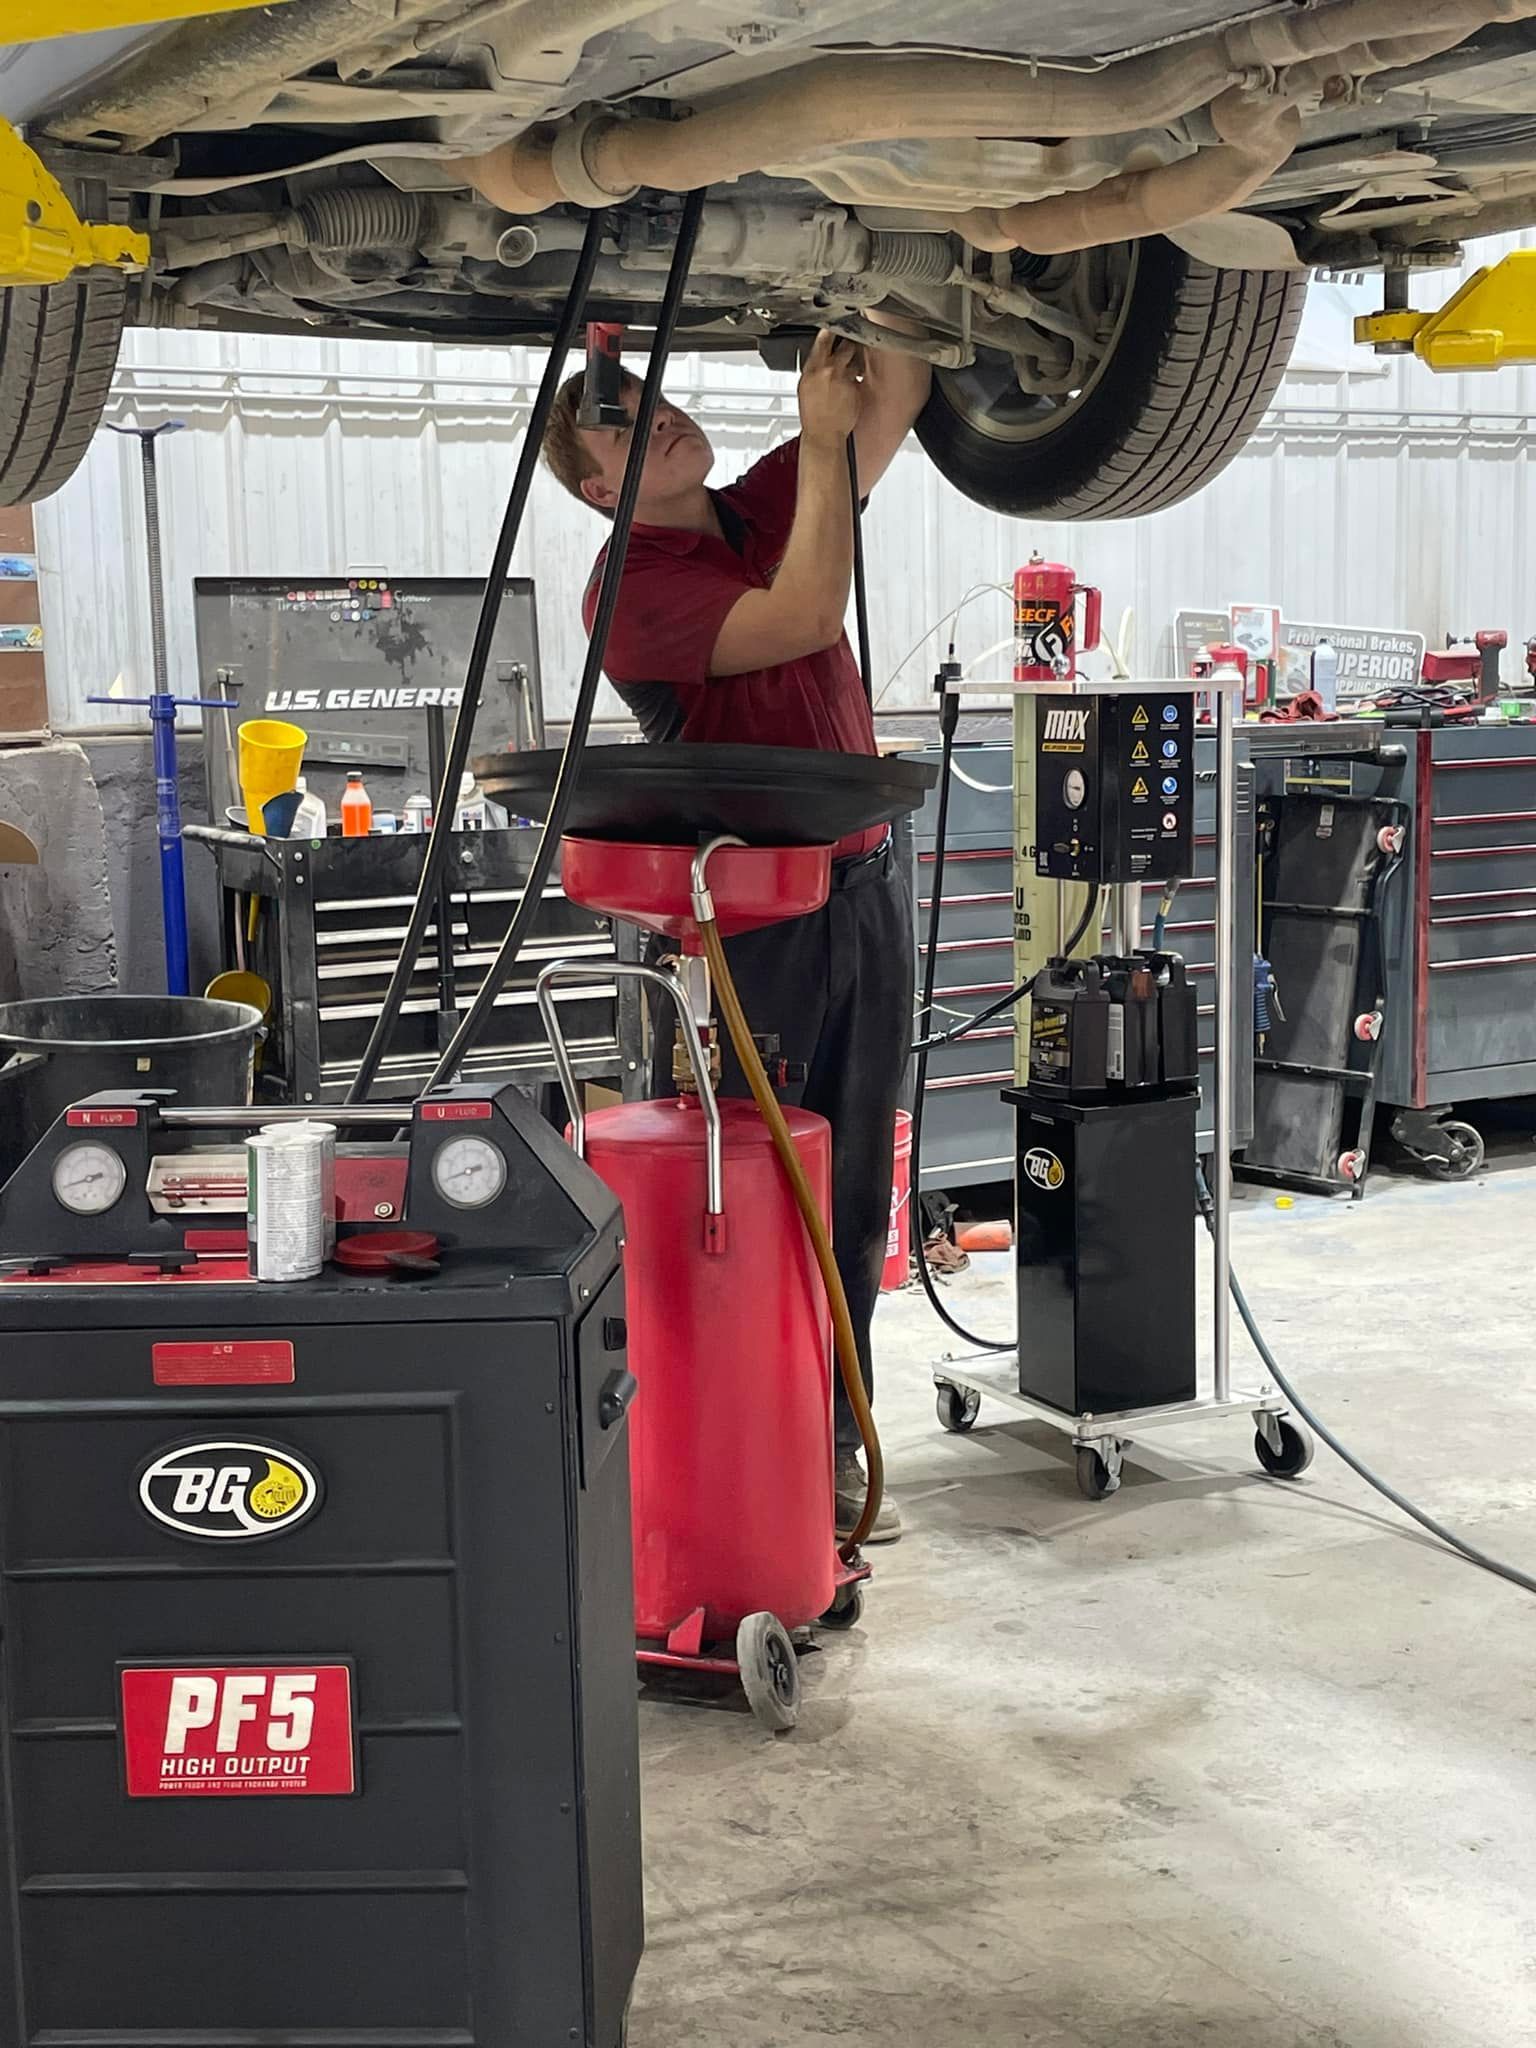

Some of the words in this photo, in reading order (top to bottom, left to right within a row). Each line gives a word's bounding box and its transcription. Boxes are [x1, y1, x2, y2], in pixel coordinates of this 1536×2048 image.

[1370, 637, 1417, 656] Brakes,
[1336, 653, 1415, 681] UPERIOR
[265, 689, 323, 711] U.S.
[325, 687, 482, 710] GENERA
[1043, 710, 1090, 740] MAX
[1015, 886, 1024, 909] U
[1014, 913, 1030, 926] SED
[83, 1114, 91, 1123] N
[437, 1107, 445, 1118] U
[173, 1466, 252, 1513] BG
[162, 1675, 317, 1754] PF5
[160, 1758, 216, 1776] HIGH
[224, 1756, 311, 1775] OUTPUT
